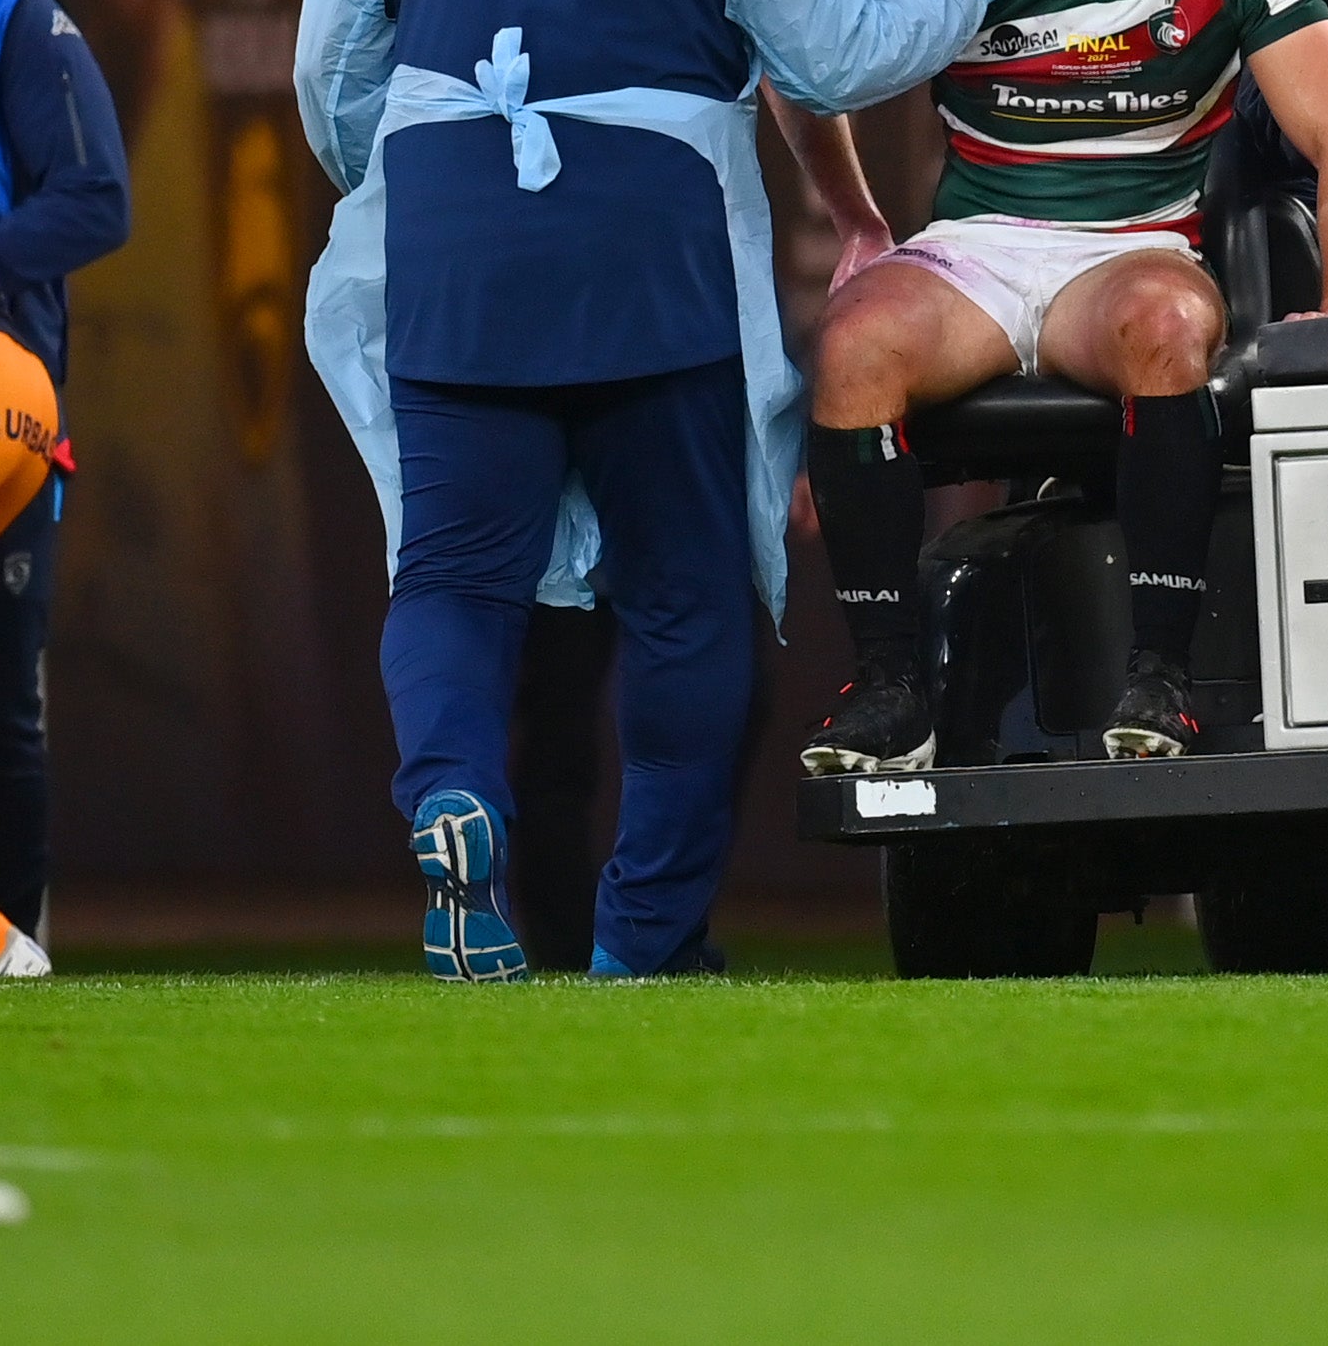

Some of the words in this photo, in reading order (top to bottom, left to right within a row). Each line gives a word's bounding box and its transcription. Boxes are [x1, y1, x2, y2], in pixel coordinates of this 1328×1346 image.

[979, 28, 1059, 56] SAMURAI
[1065, 34, 1130, 53] FINAL
[991, 83, 1105, 114] Topps
[1108, 90, 1189, 113] Tiles
